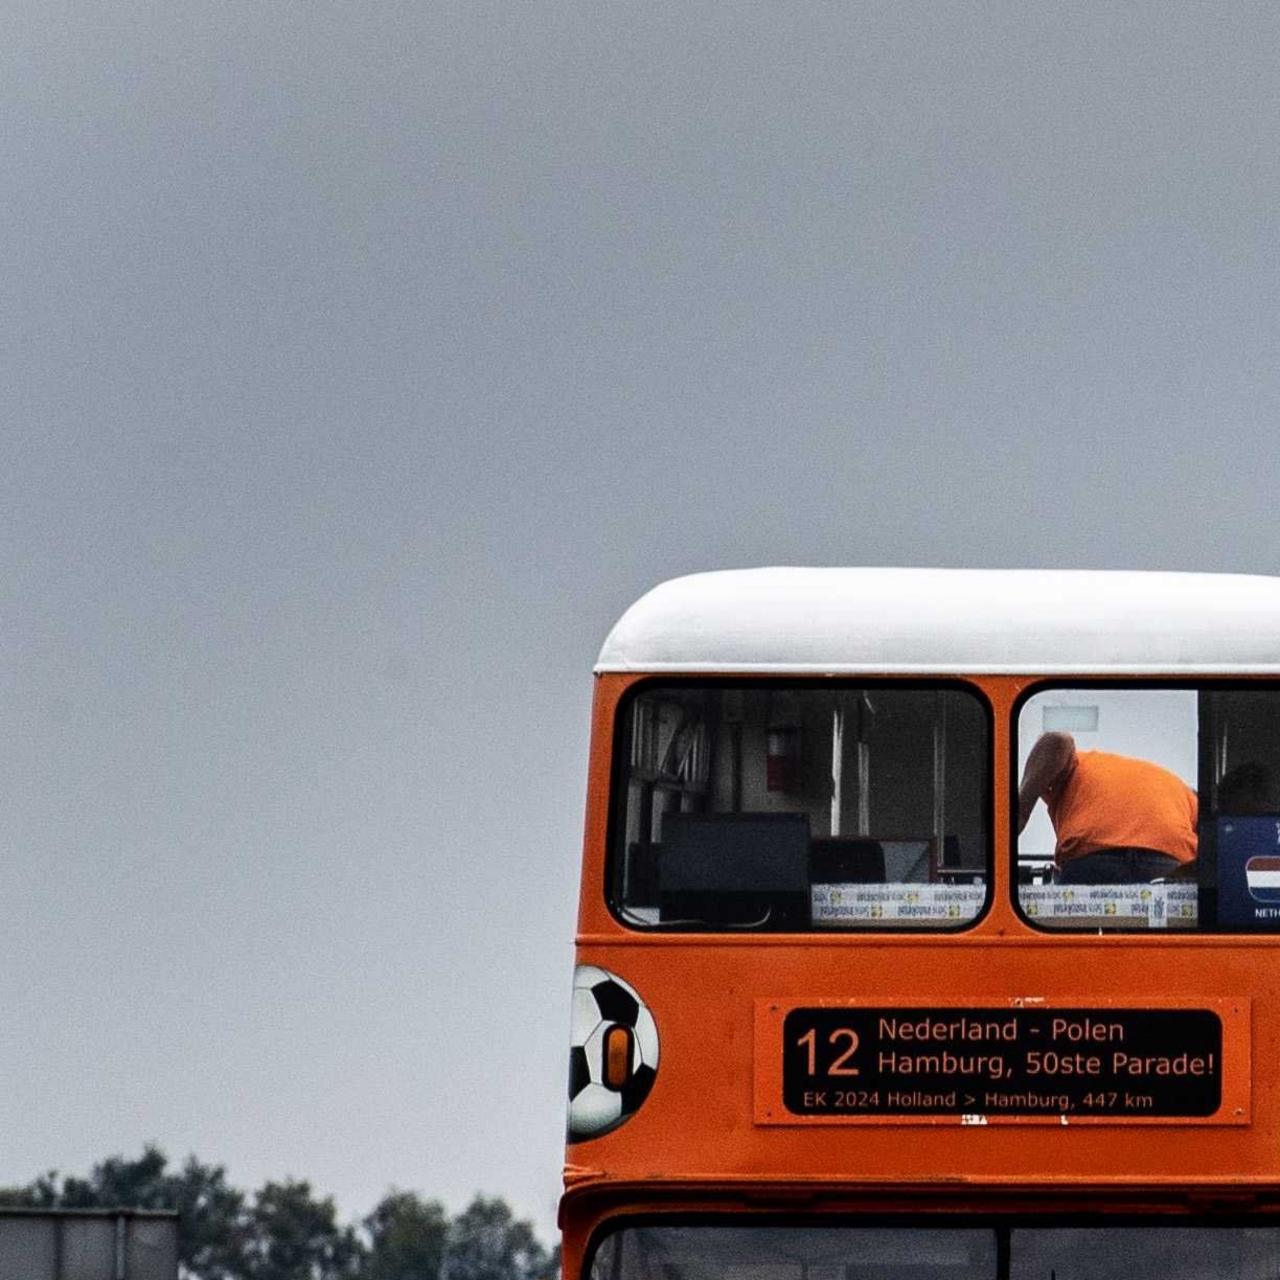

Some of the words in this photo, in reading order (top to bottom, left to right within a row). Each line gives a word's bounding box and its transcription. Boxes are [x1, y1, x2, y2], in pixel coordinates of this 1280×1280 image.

[879, 1018, 1018, 1041] Nederland
[1052, 1018, 1125, 1041] Polen
[797, 1028, 860, 1075] 12
[878, 1051, 1013, 1079] Hamburg,
[1026, 1051, 1102, 1075] 50ste
[1112, 1052, 1214, 1075] Parade!
[803, 1091, 827, 1107] EK
[834, 1091, 879, 1107] 2024
[887, 1091, 956, 1107] Holland
[985, 1092, 1076, 1111] Hamburg,
[1082, 1092, 1119, 1108] 447
[1124, 1092, 1154, 1108] km
